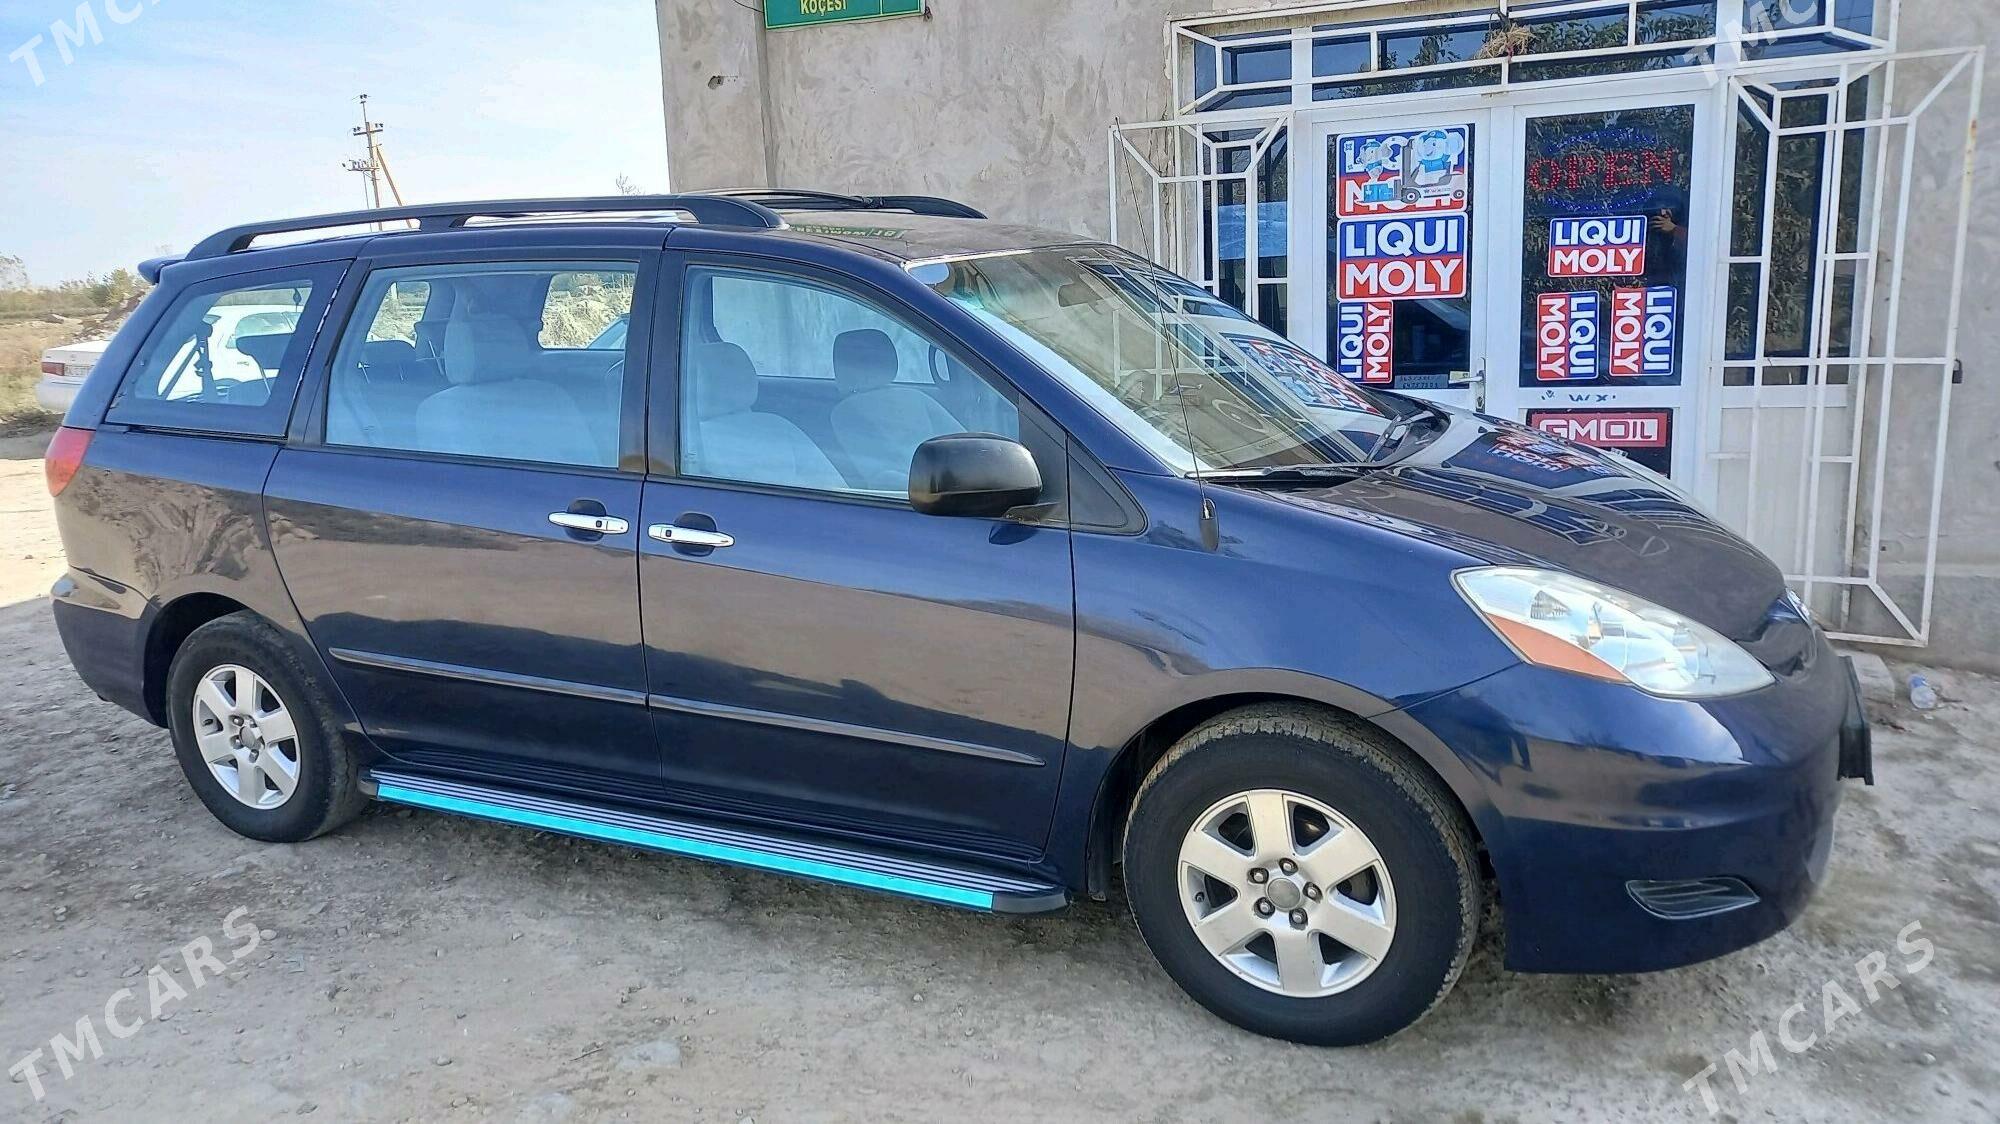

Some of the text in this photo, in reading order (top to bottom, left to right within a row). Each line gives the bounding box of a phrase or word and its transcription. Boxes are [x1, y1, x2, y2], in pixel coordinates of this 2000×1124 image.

[1528, 149, 1672, 190] OPEN
[1345, 219, 1459, 257] LIQUI
[1553, 248, 1642, 273] MOLY
[1554, 219, 1641, 246] LIQUI
[1345, 259, 1462, 295] MOLY
[1340, 306, 1364, 378] LIQUI
[1366, 303, 1391, 379] MOLY
[1540, 298, 1566, 377] MOLY
[1568, 296, 1596, 374] LIQUI
[1613, 292, 1641, 373] MOLY
[1643, 290, 1673, 371] LIQUI
